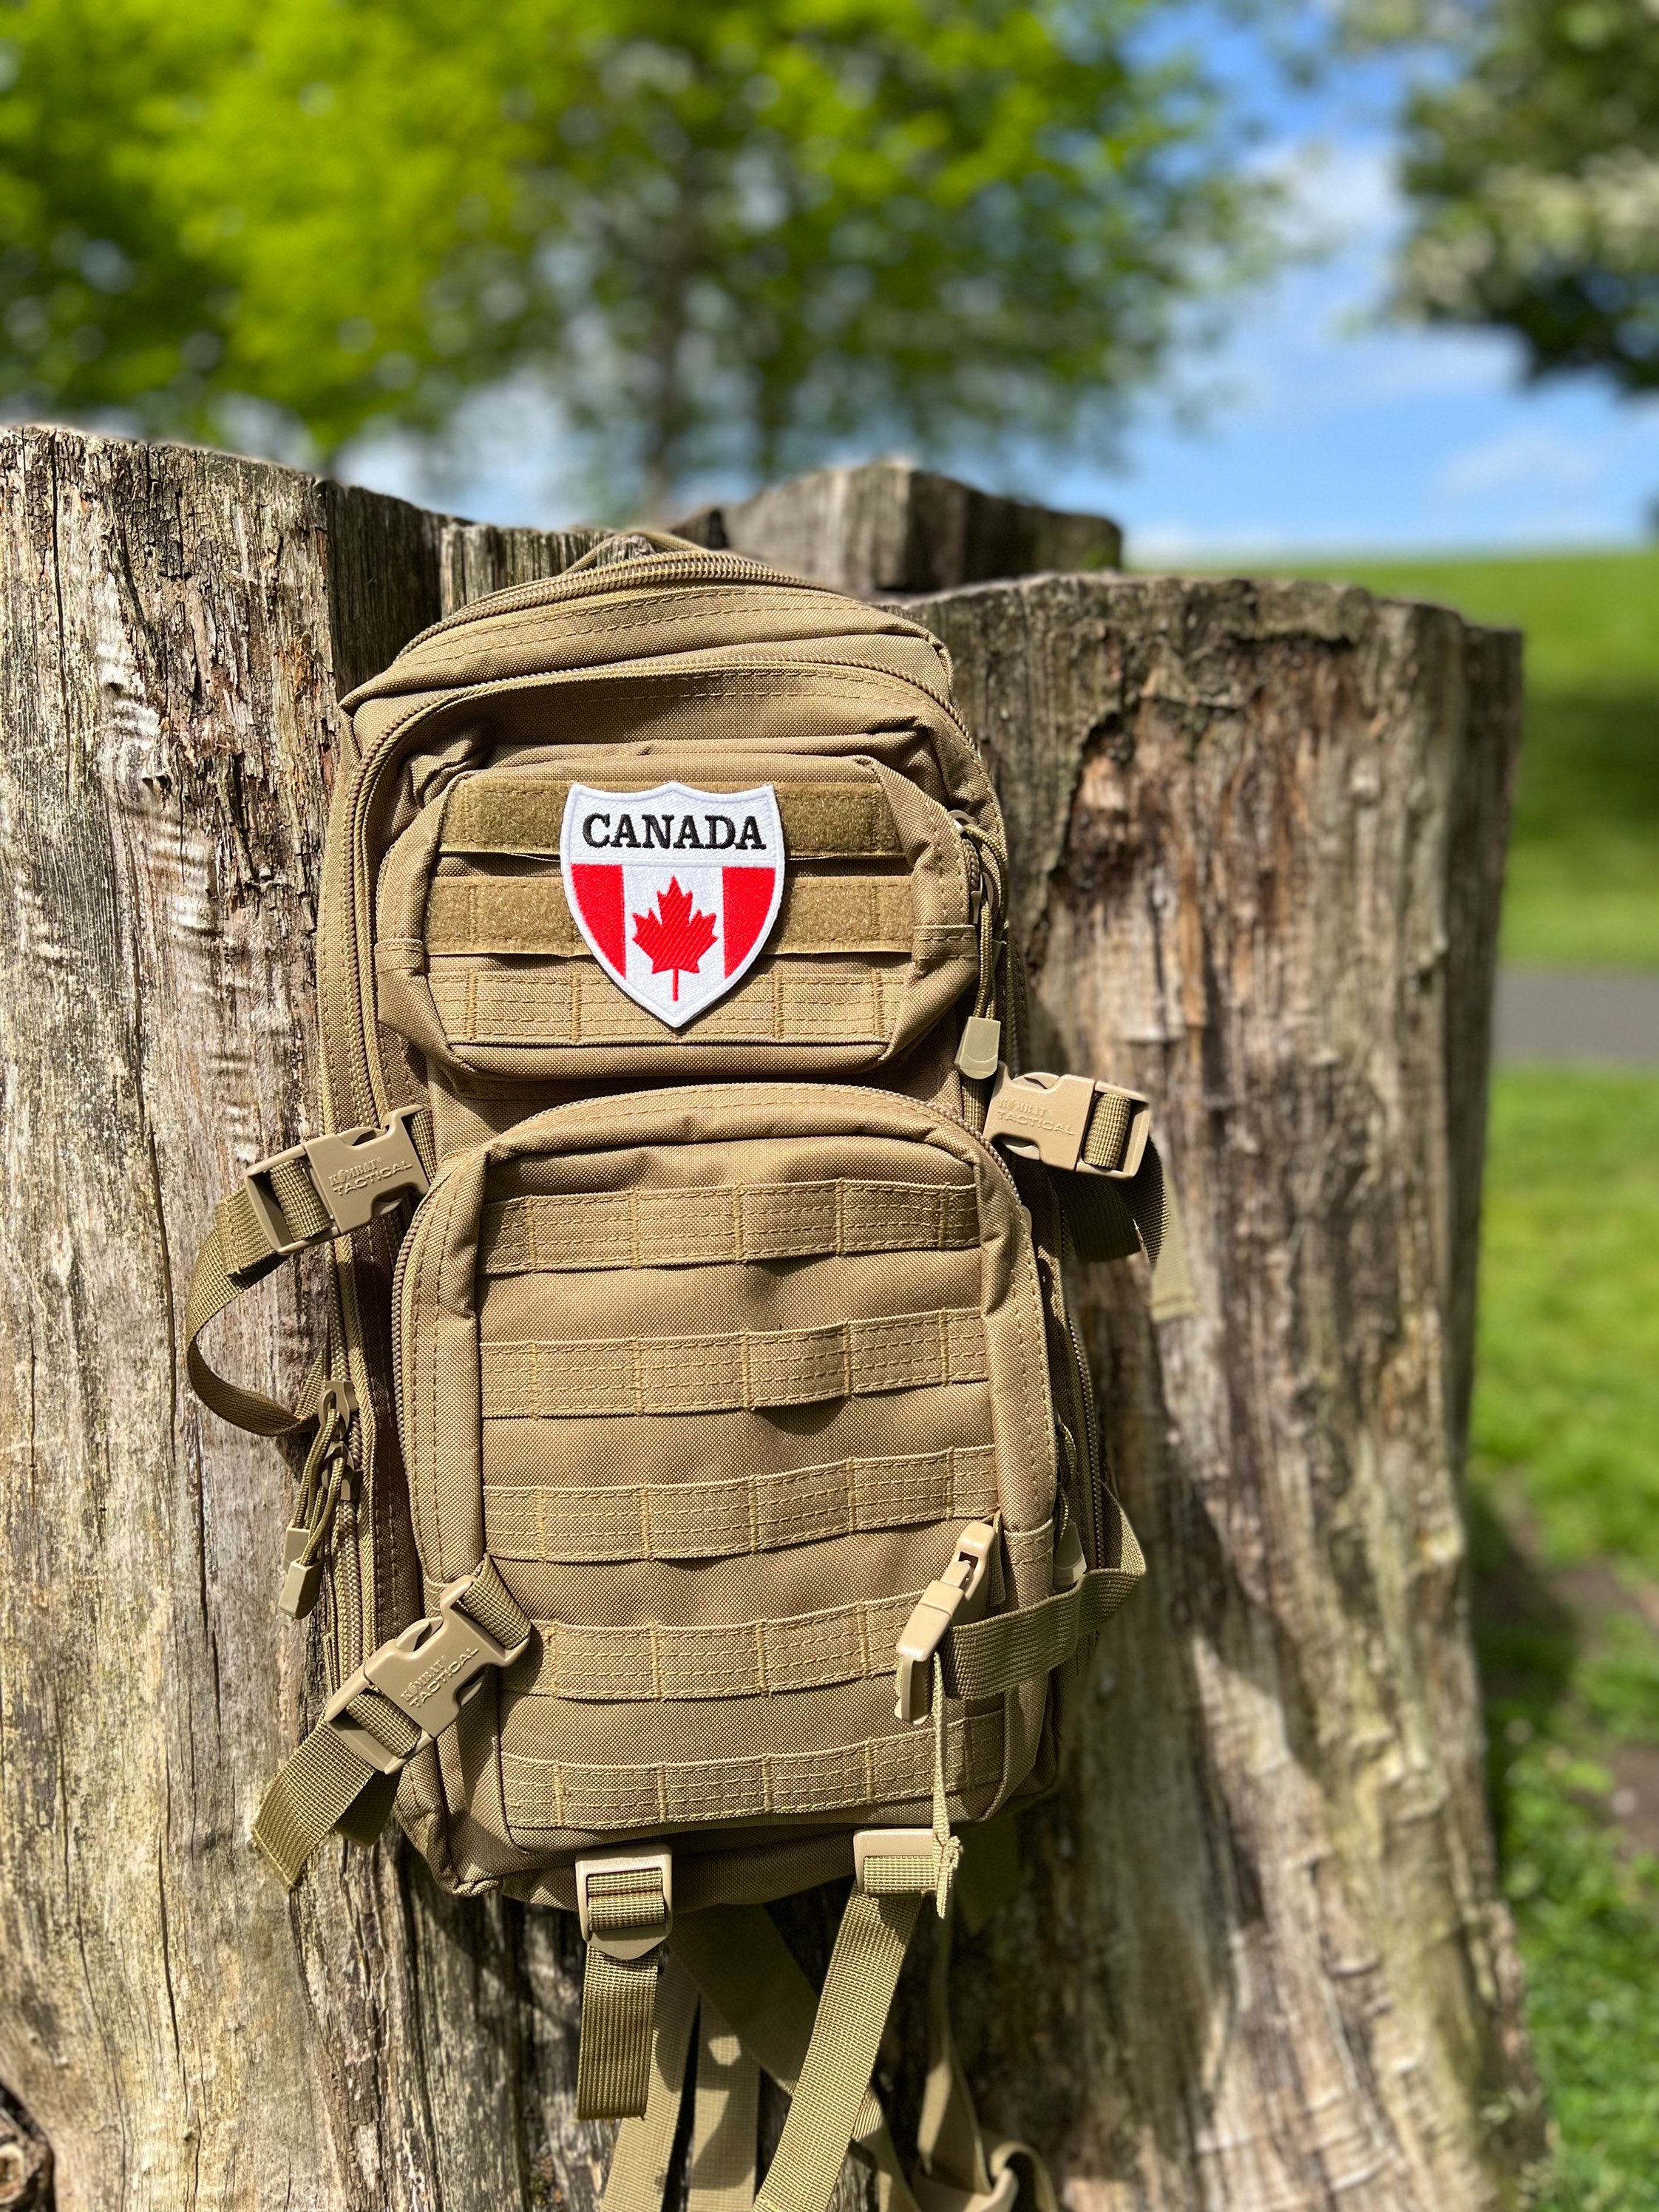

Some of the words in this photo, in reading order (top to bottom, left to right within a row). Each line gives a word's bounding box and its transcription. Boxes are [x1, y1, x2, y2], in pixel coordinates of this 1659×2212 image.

[582, 812, 767, 849] CANADA
[997, 1110, 1074, 1136] TACTICAL
[333, 1160, 413, 1195] TACTICAL
[409, 1648, 479, 1708] TACTICAL
